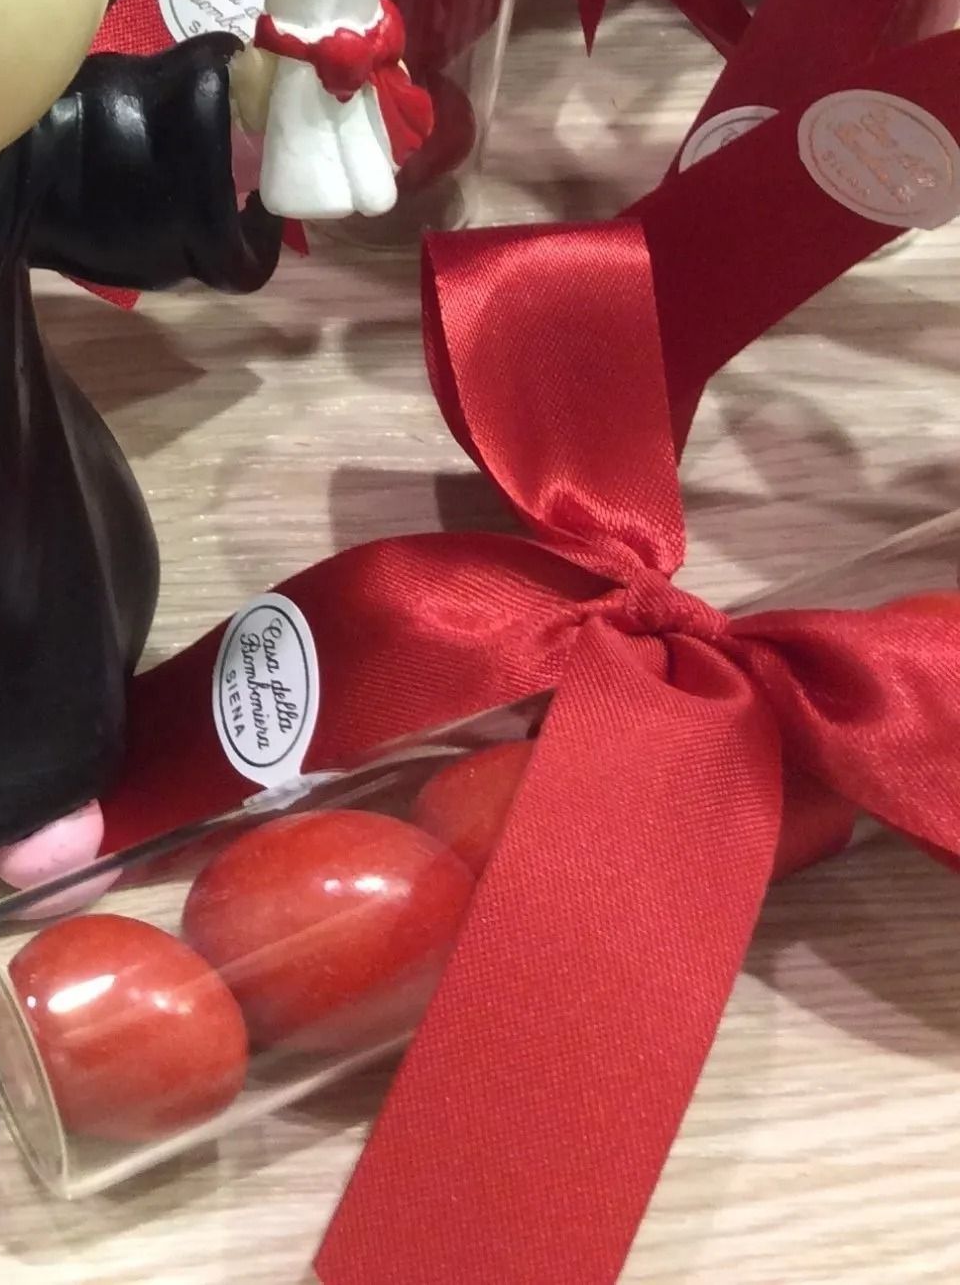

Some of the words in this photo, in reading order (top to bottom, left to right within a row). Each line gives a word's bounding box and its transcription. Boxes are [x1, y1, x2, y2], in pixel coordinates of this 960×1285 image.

[262, 617, 283, 674] Casa
[226, 669, 245, 738] SIENA
[240, 632, 271, 751] Bomboniera
[271, 679, 299, 734] della
